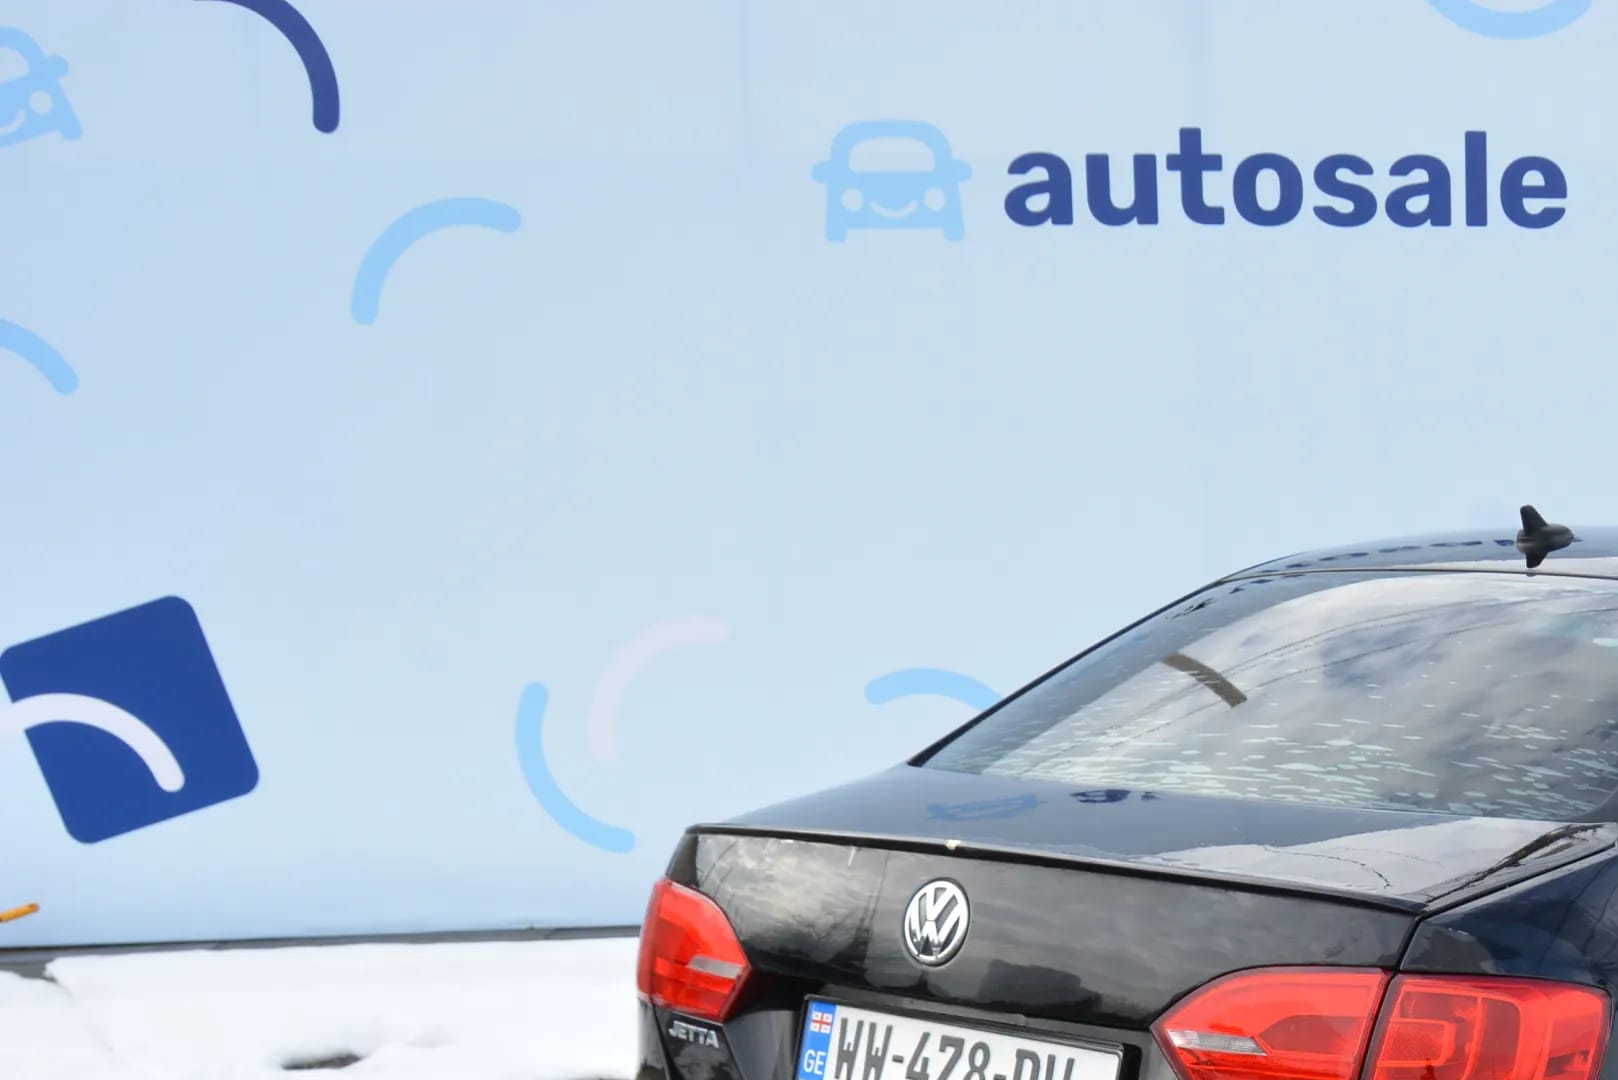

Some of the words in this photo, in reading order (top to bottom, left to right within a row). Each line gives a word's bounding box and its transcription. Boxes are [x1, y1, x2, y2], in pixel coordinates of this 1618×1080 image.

[1003, 126, 1569, 230] autosale
[668, 1020, 720, 1049] JETTA
[803, 1048, 826, 1075] GE
